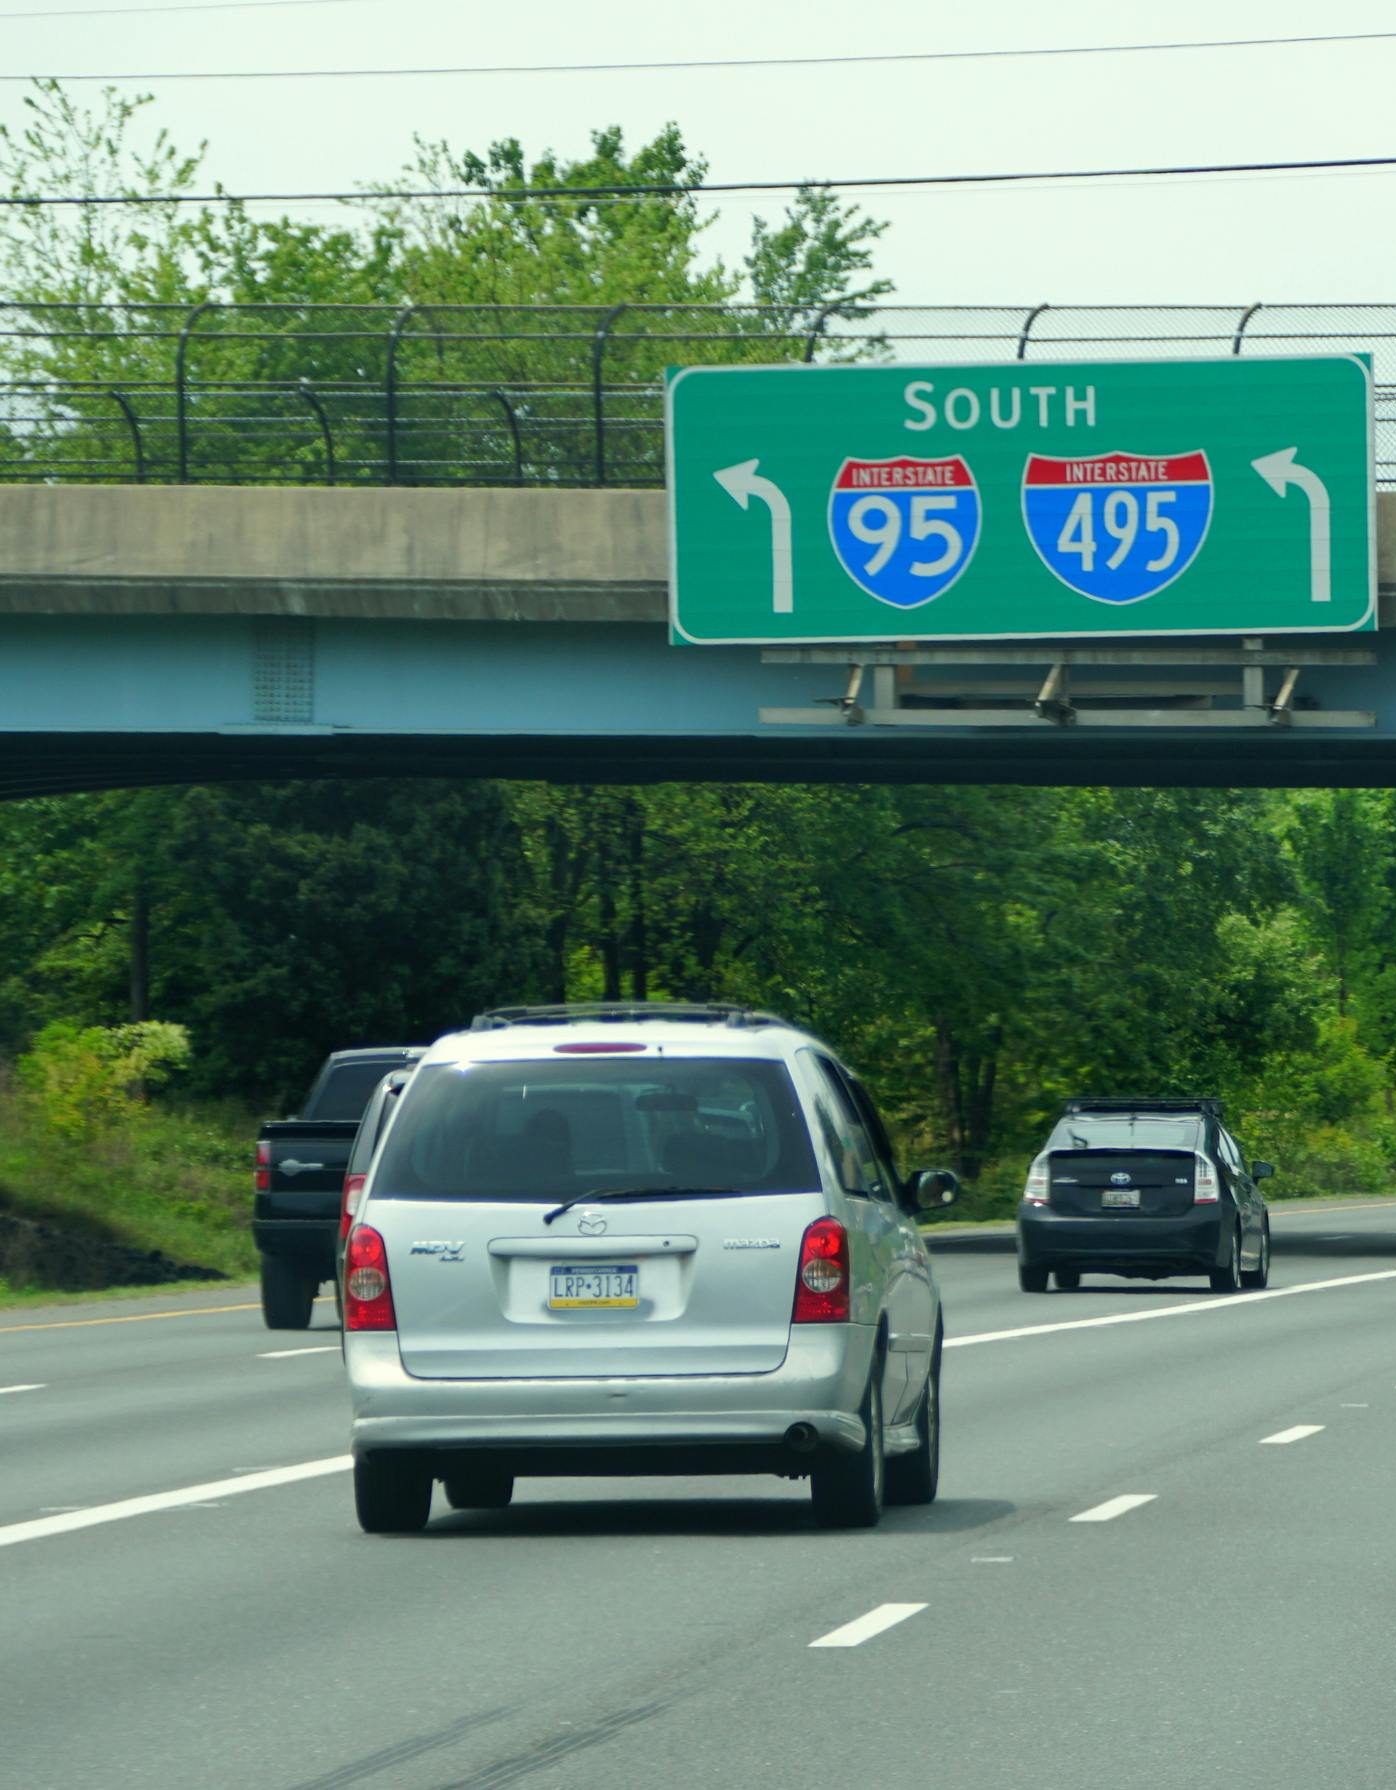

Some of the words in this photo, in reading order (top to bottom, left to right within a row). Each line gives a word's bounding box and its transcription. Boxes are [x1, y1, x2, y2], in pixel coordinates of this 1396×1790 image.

[903, 380, 1097, 431] SOUTH
[852, 467, 957, 488] INTERSTATE
[1065, 461, 1169, 482] INTERSTATE
[846, 494, 963, 577] 95
[1057, 490, 1180, 571] 495
